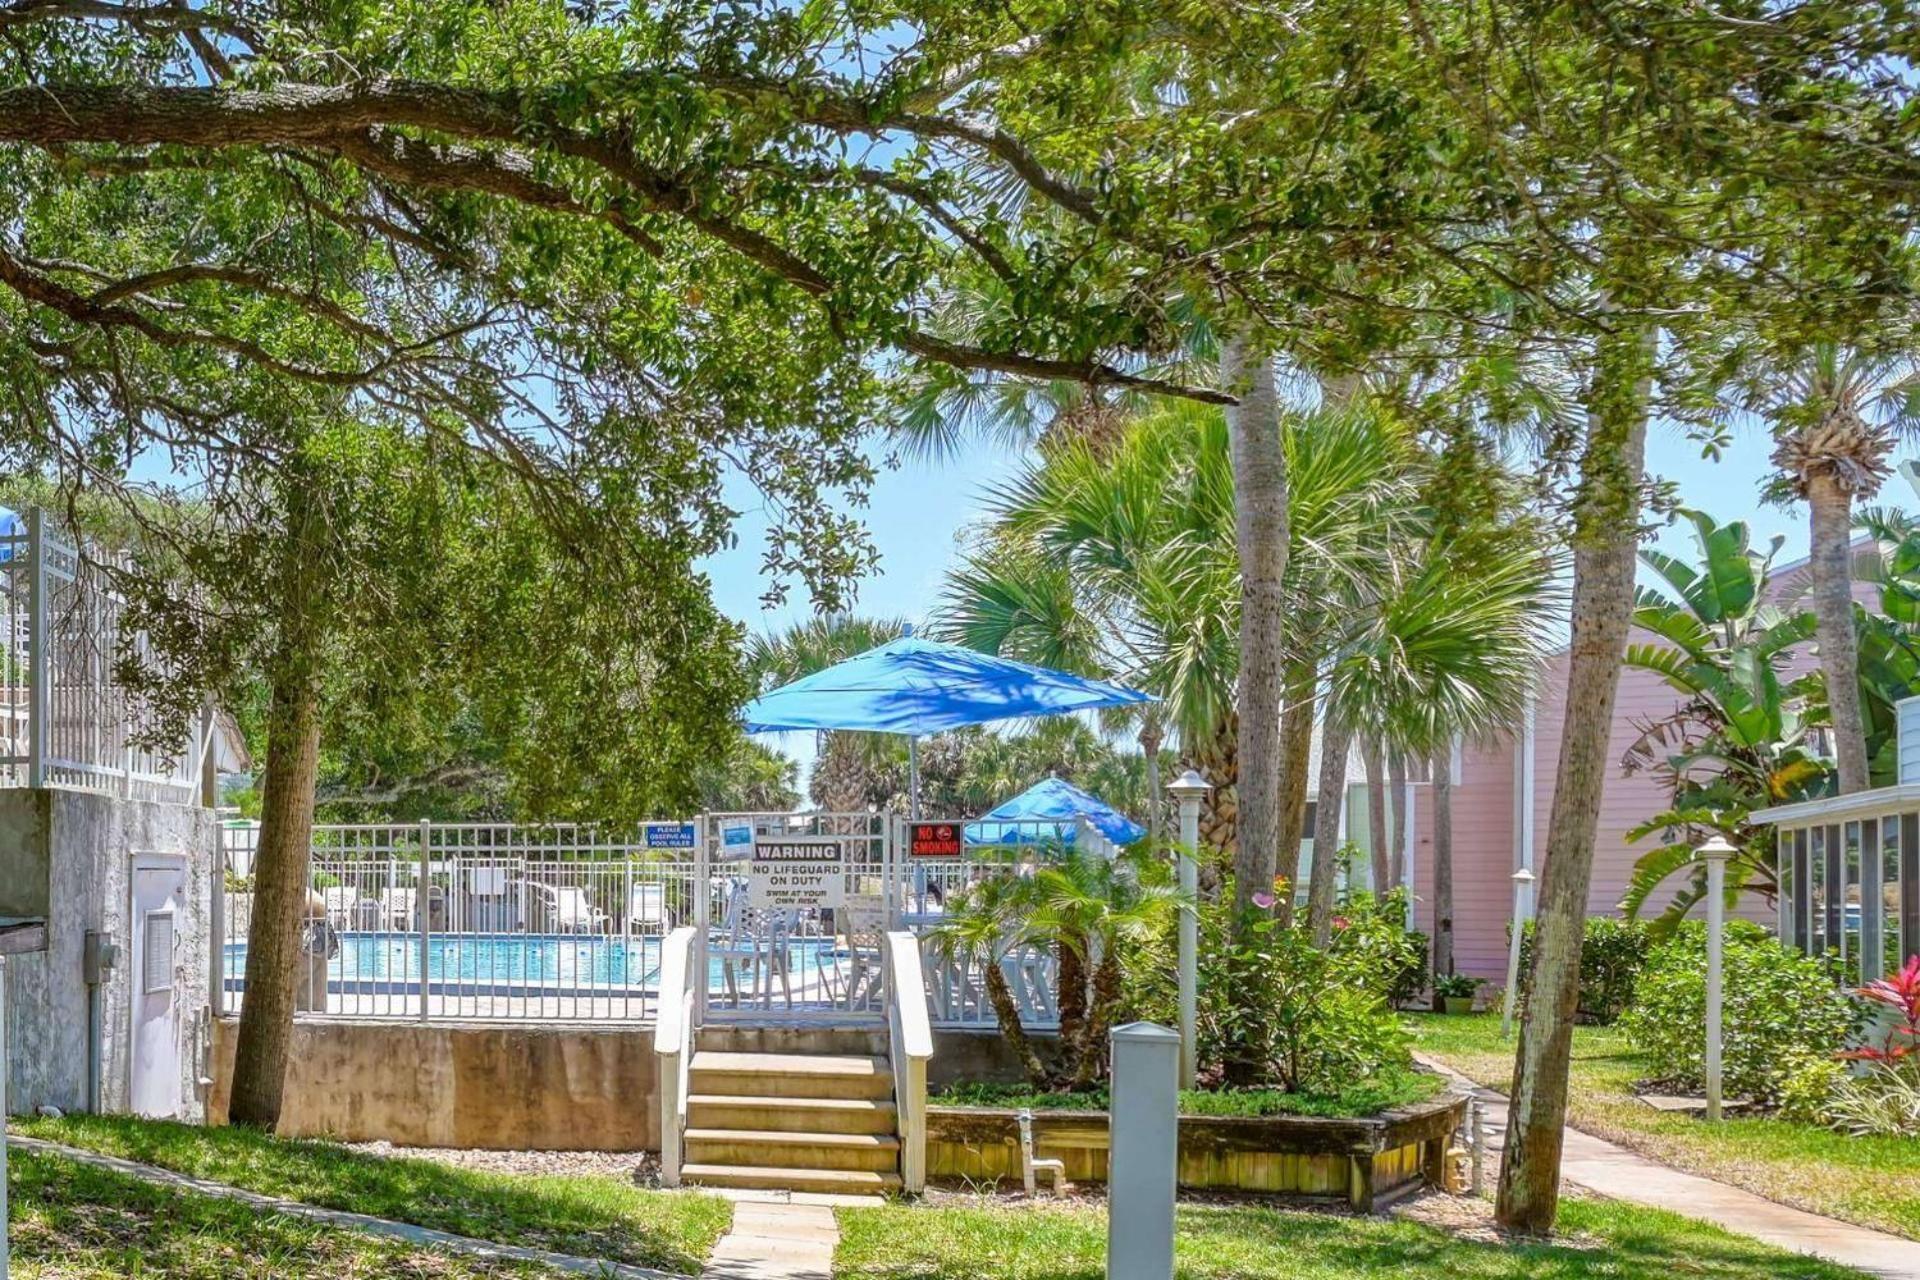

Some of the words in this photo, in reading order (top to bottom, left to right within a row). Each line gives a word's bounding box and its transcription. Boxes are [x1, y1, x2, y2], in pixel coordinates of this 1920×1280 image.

[918, 826, 933, 840] NO
[757, 846, 835, 858] WARNING
[913, 841, 958, 855] SMOKING
[753, 865, 769, 874] NO
[774, 865, 840, 874] LIFEGUARD
[770, 876, 787, 885] ON
[791, 876, 822, 885] DUTY
